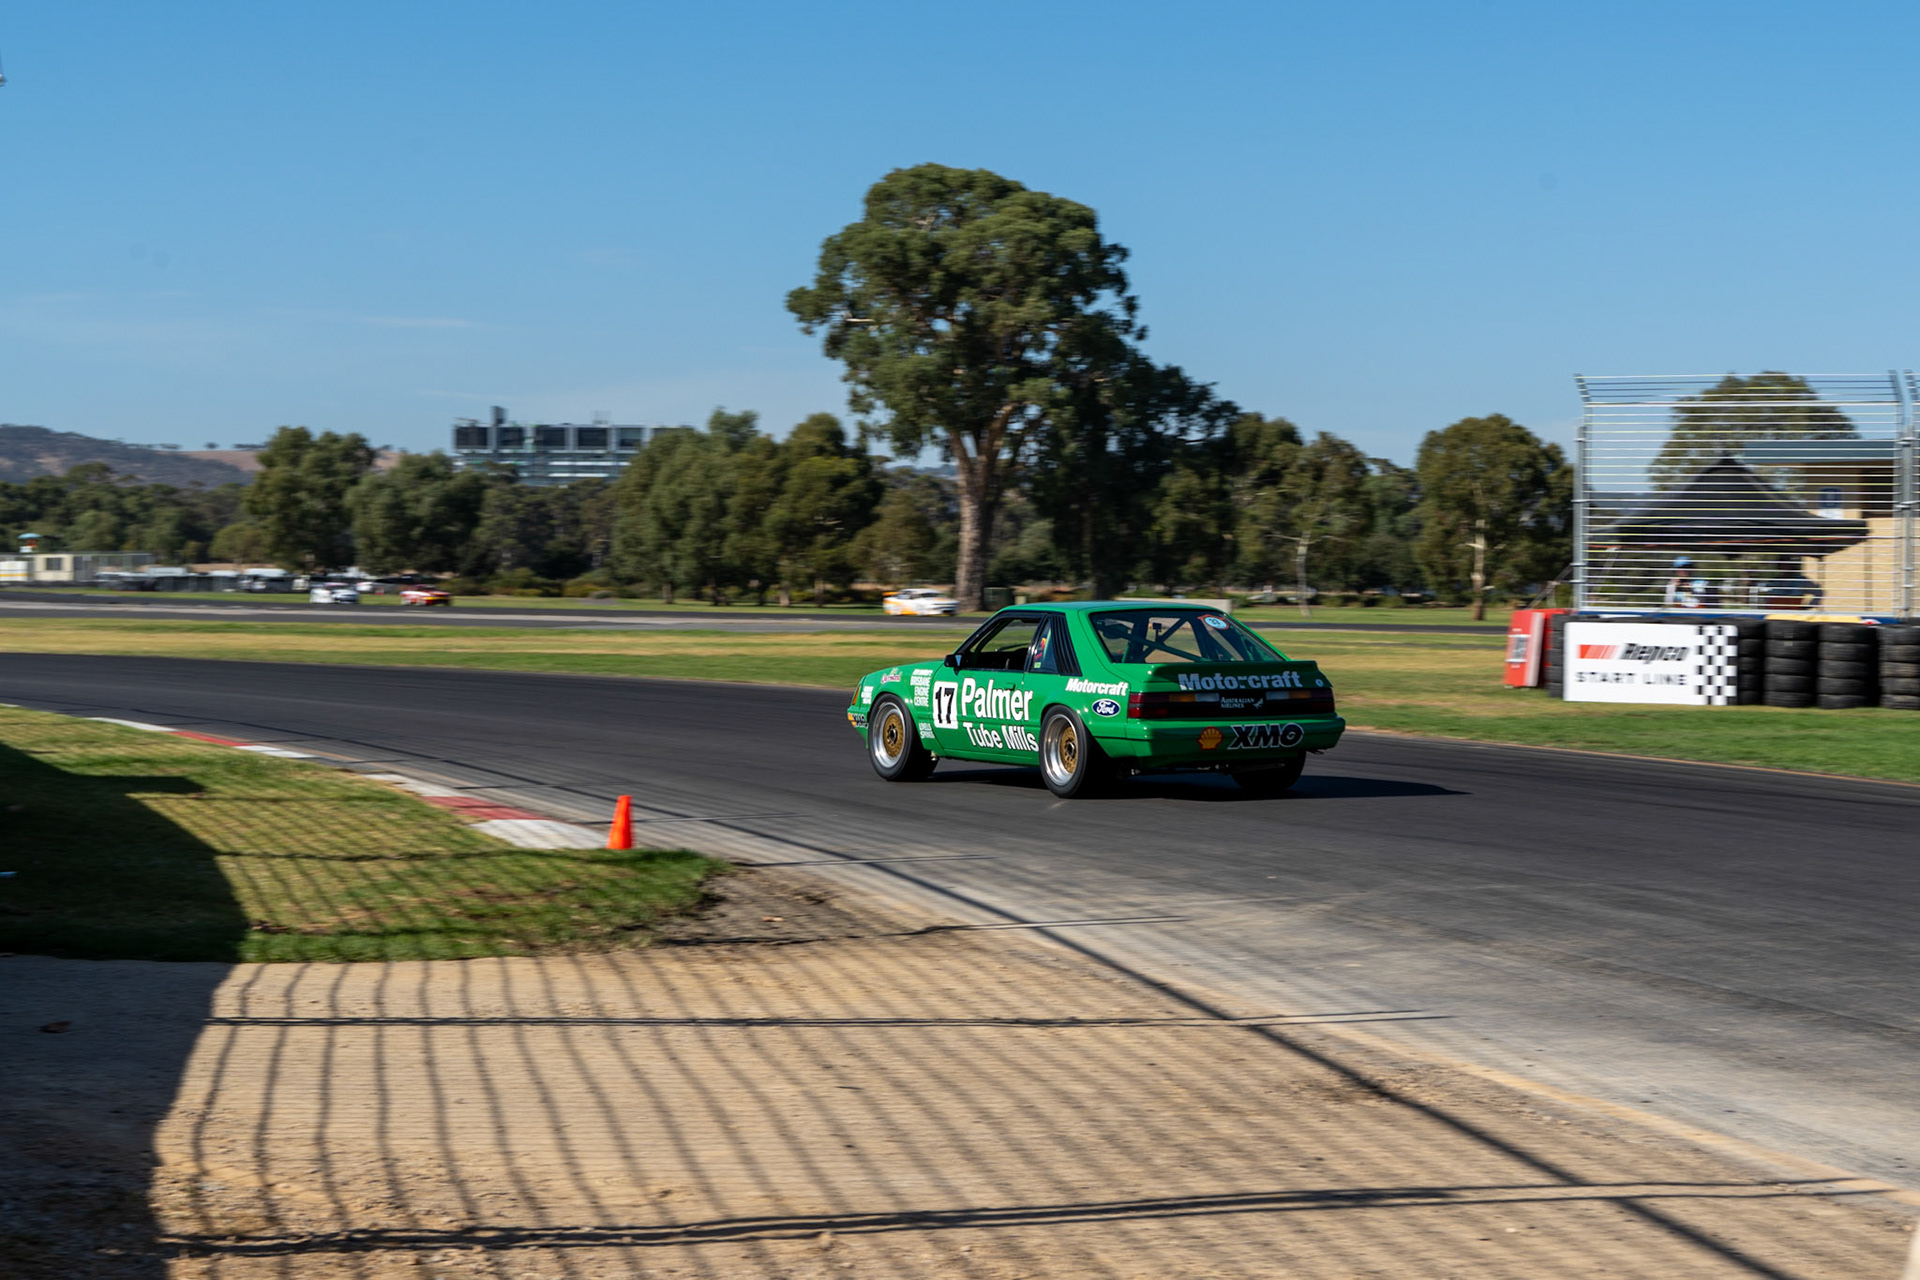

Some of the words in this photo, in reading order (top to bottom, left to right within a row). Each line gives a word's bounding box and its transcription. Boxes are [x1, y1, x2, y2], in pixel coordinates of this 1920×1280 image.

[1620, 643, 1690, 664] Repco
[1065, 678, 1129, 696] Motorcraft
[1576, 672, 1636, 684] START
[1643, 673, 1687, 686] LINE
[935, 686, 955, 724] 17
[961, 677, 1033, 722] Palmer
[1096, 700, 1117, 715] Ford
[962, 721, 1003, 749] Tube
[1001, 724, 1040, 752] Mills
